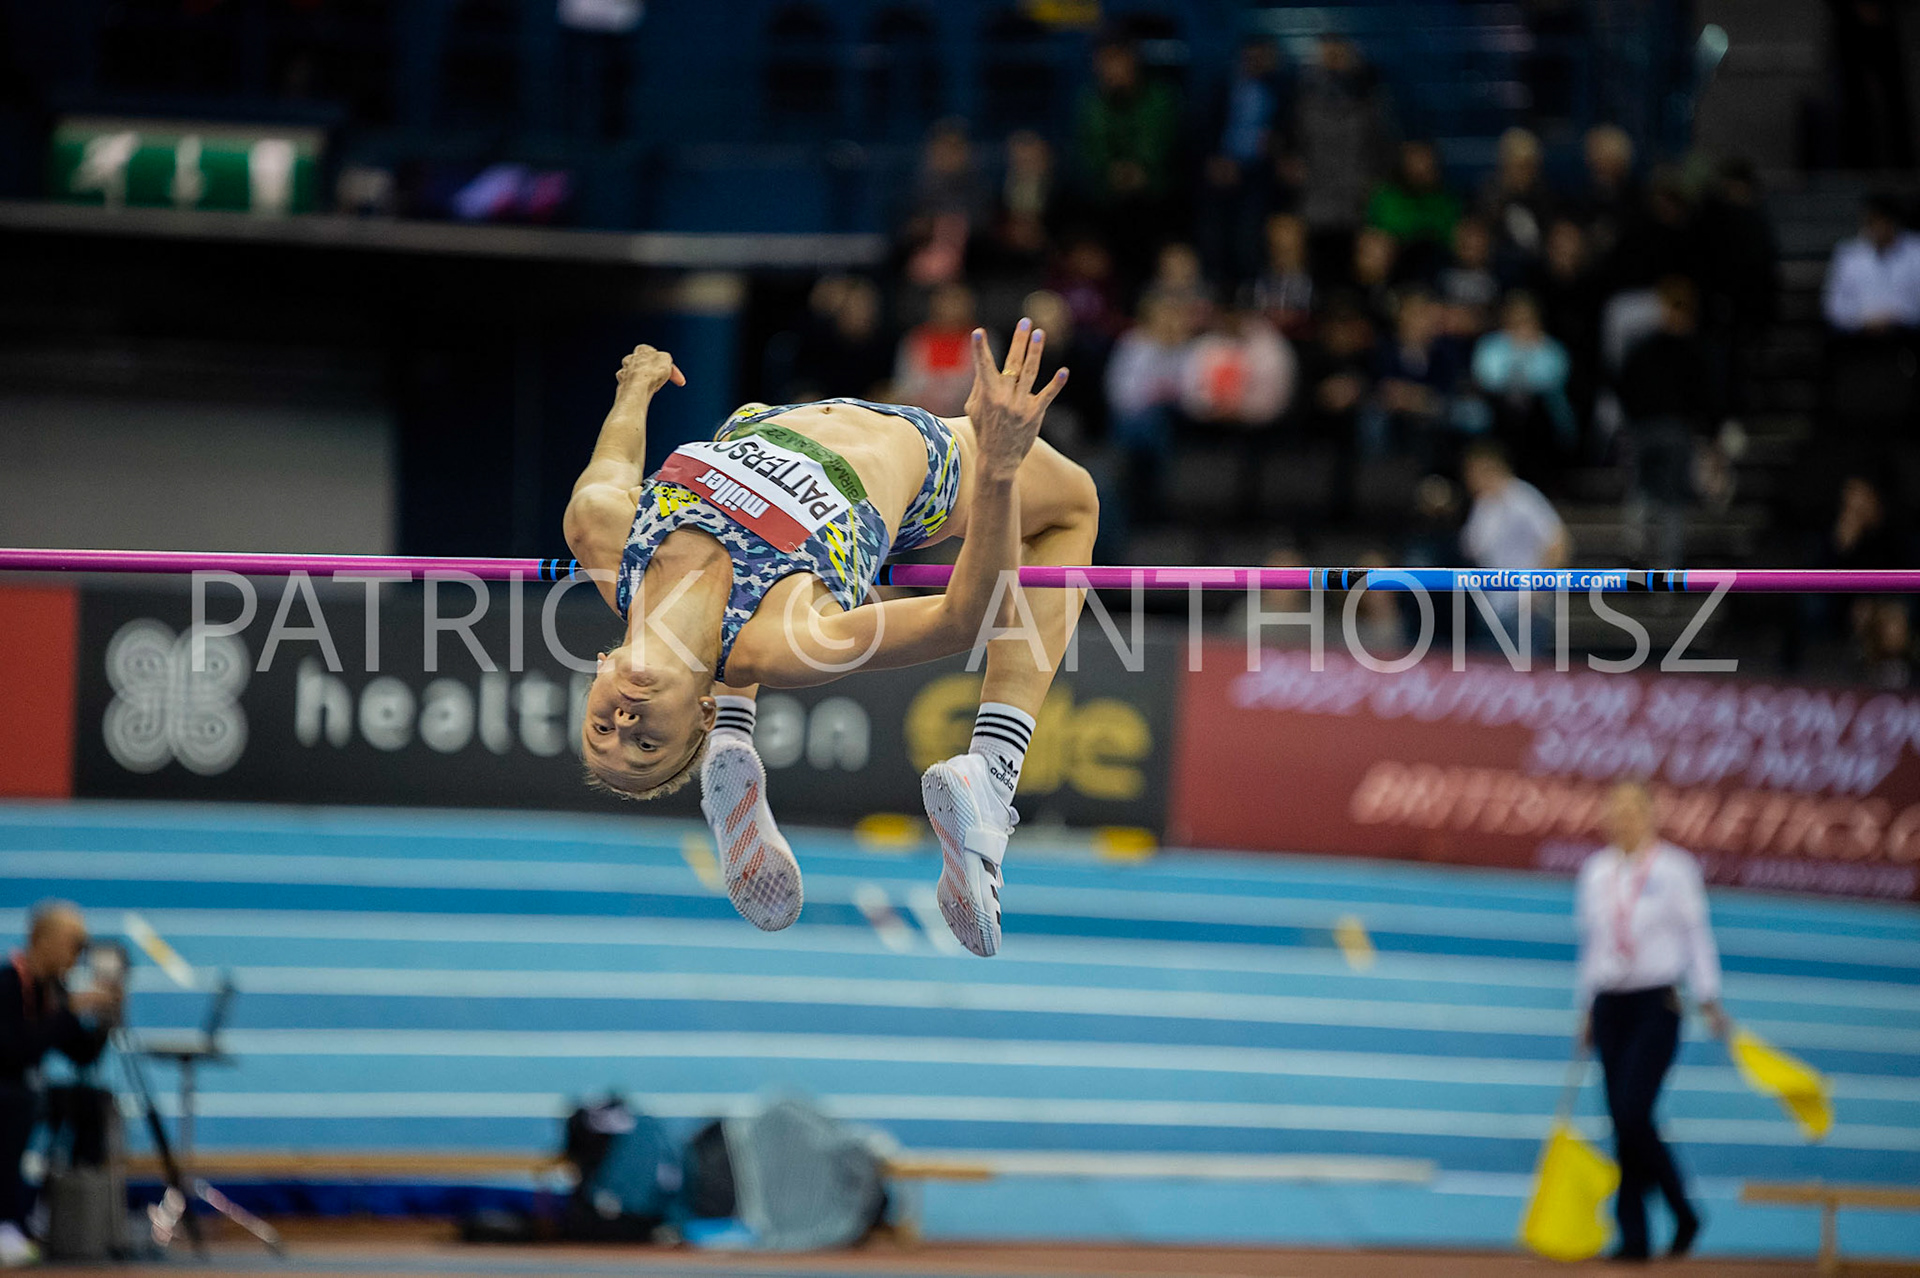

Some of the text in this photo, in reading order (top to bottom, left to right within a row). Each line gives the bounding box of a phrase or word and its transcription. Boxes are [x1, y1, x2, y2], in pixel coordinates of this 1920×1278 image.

[694, 468, 771, 520] müller
[704, 440, 839, 521] PATTERSO
[1457, 570, 1622, 591] nordicsport.com
[295, 655, 871, 772] healtan
